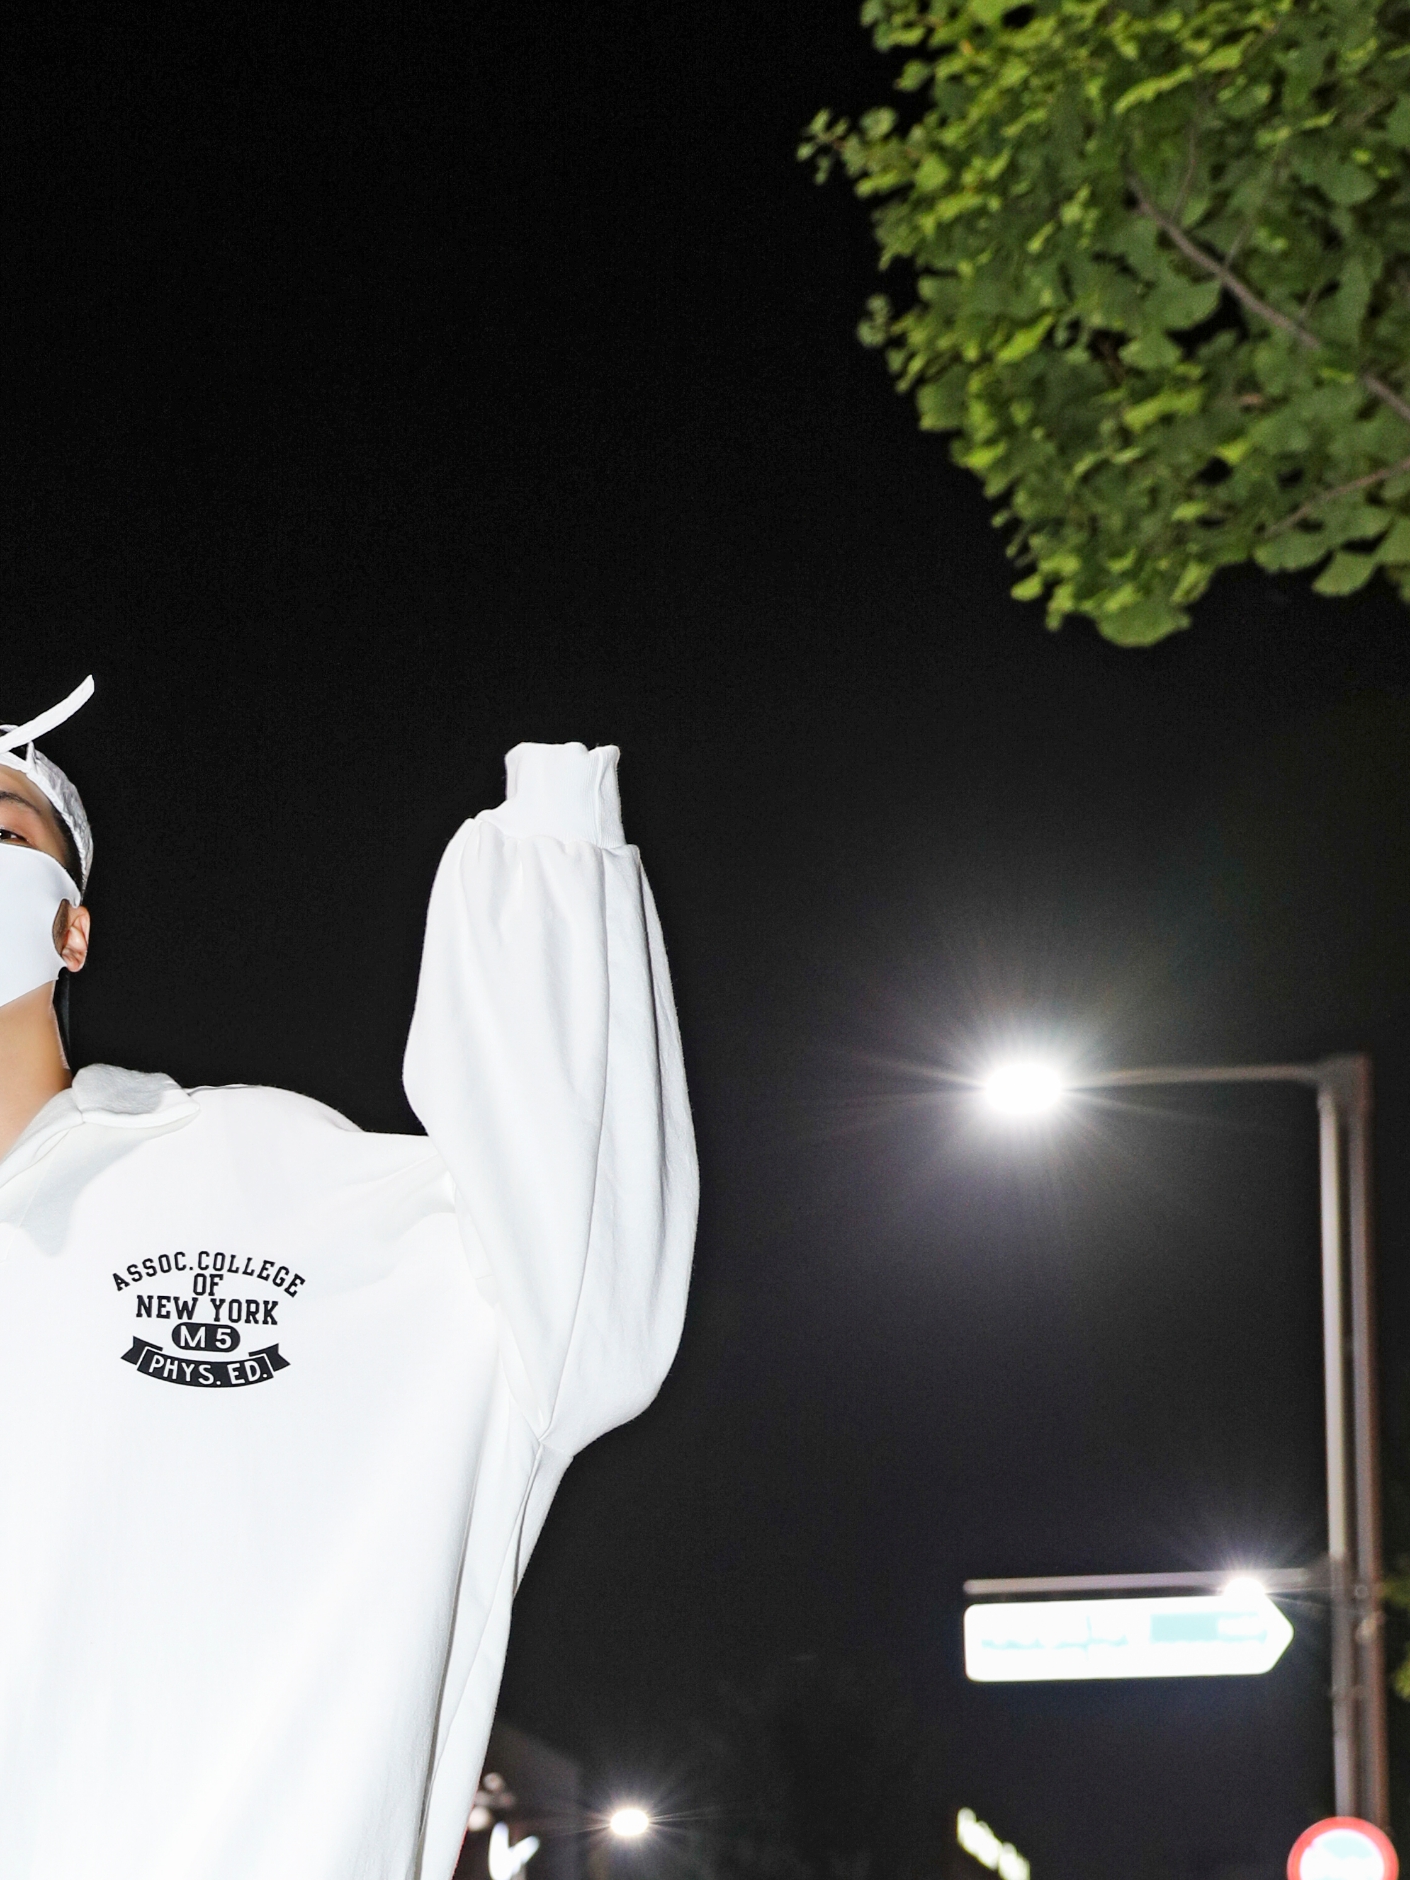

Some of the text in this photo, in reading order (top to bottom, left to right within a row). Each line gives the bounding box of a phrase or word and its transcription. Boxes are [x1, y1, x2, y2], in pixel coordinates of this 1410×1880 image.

[193, 1273, 224, 1297] OF
[136, 1294, 279, 1325] NEW YORK
[148, 1354, 268, 1386] PHYS. ED.
